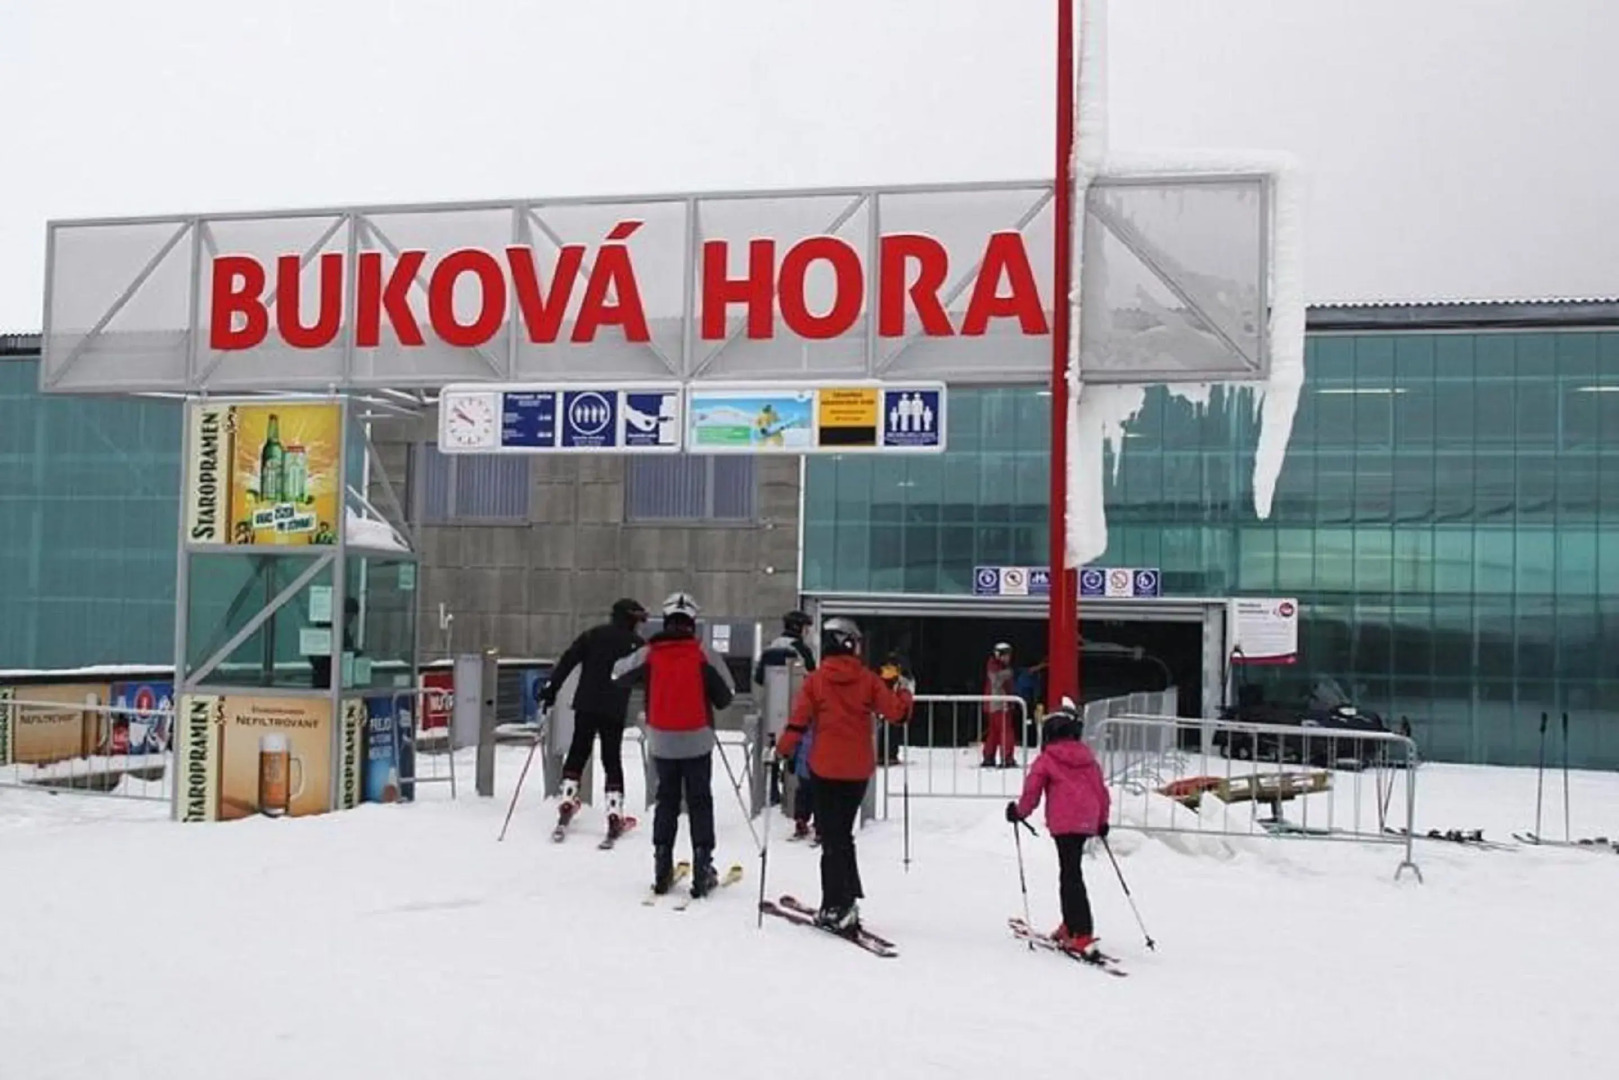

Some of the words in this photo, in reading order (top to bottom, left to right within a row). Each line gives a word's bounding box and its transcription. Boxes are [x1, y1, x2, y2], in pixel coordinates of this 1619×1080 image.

[210, 220, 651, 350] BUKOVÁ
[701, 231, 1050, 341] HORA
[192, 412, 219, 540] STAROPRAMEN
